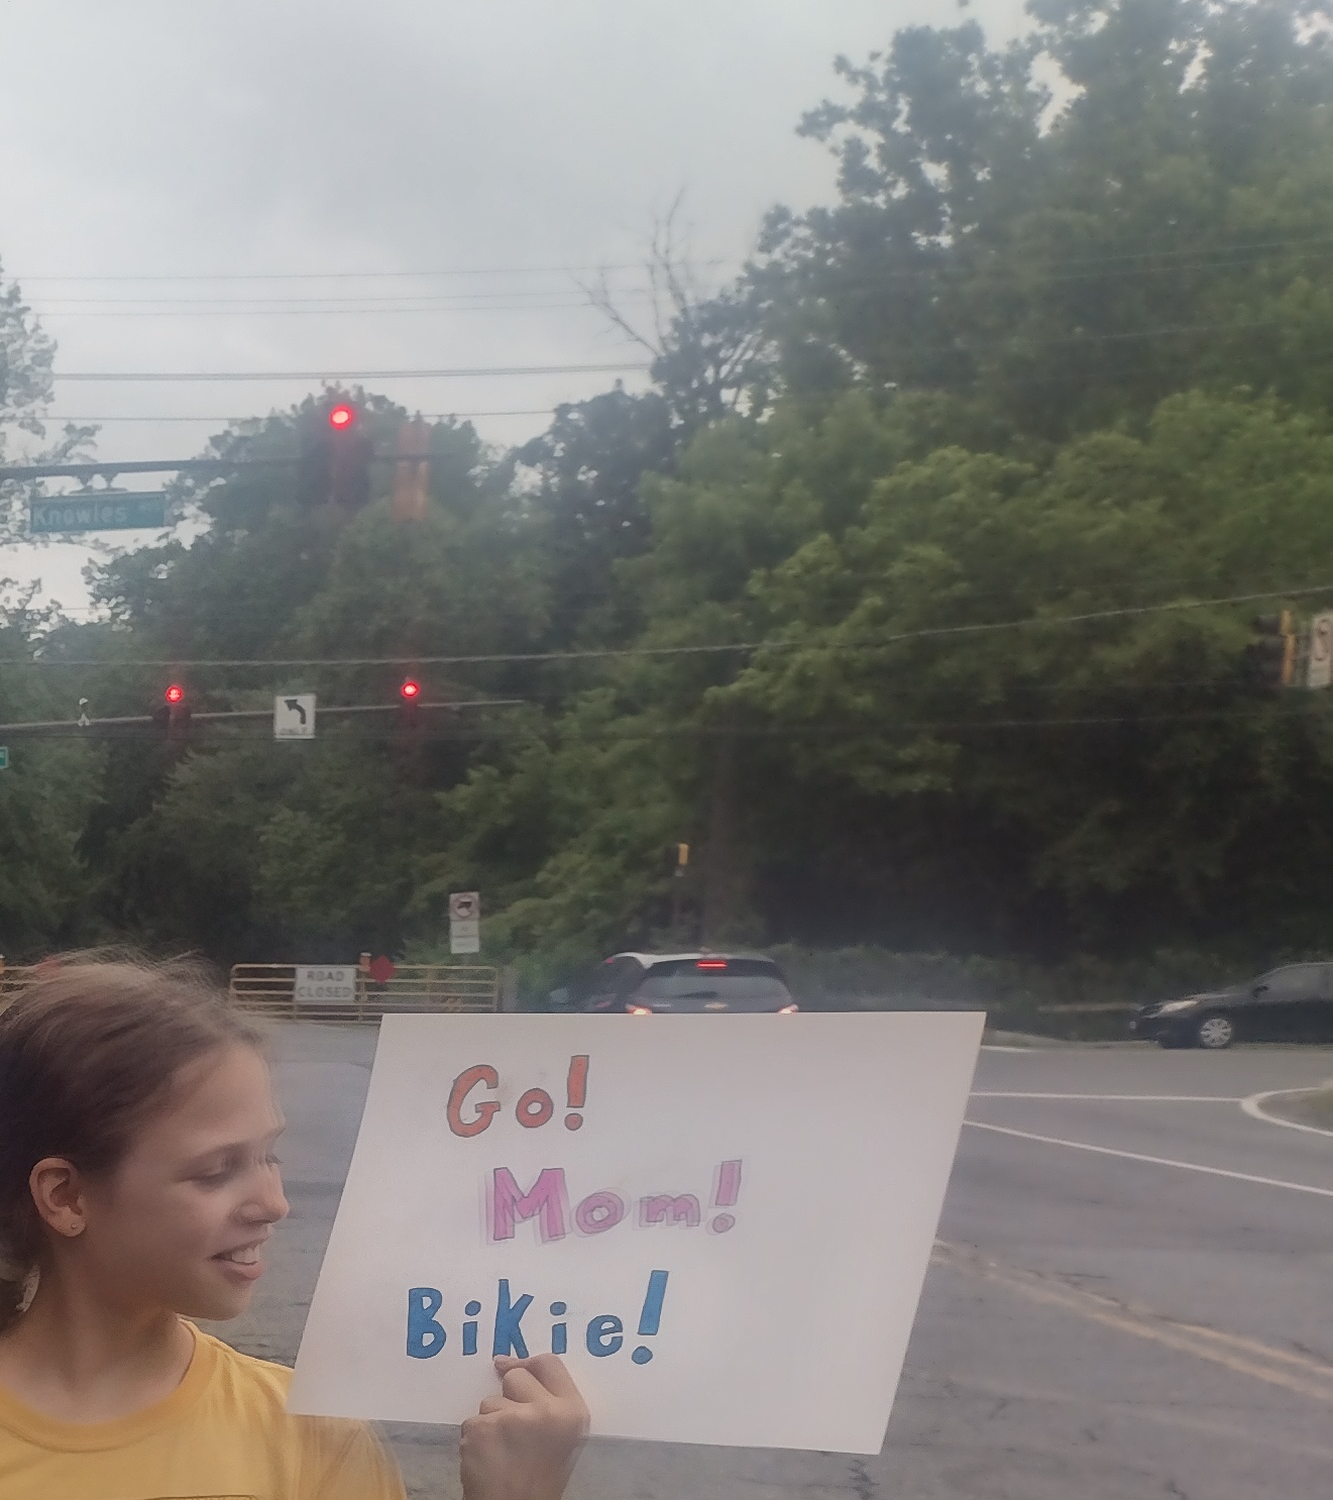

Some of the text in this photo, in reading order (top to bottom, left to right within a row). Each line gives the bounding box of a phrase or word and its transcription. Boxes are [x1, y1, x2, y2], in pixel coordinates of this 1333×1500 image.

[33, 502, 128, 526] Knowles
[307, 970, 345, 982] ROAD
[297, 986, 352, 998] CLOSED
[446, 1054, 590, 1138] Go!
[486, 1158, 744, 1244] Mom!
